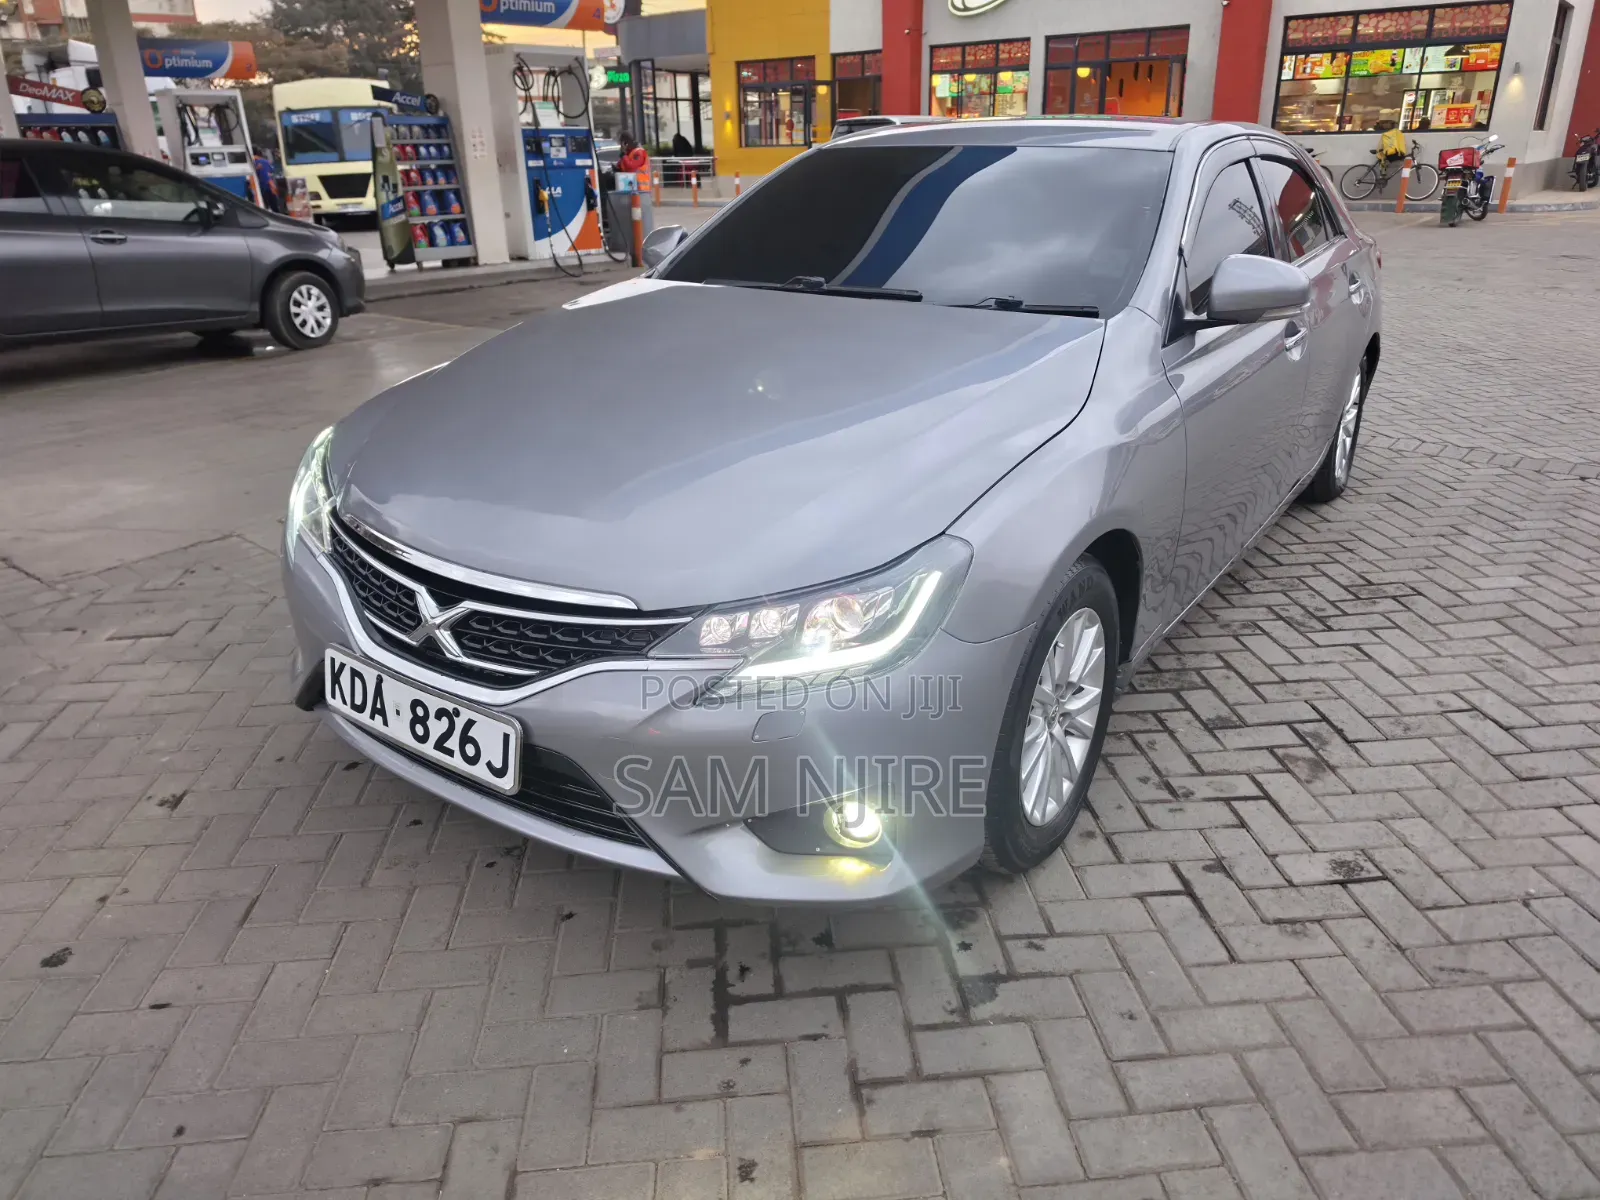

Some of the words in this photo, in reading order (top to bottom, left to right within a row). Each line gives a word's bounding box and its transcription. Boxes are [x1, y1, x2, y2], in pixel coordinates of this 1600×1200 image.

[20, 83, 76, 102] DeoMAX
[392, 91, 421, 107] Accel
[330, 656, 389, 728] KDA
[409, 698, 511, 779] 826J
